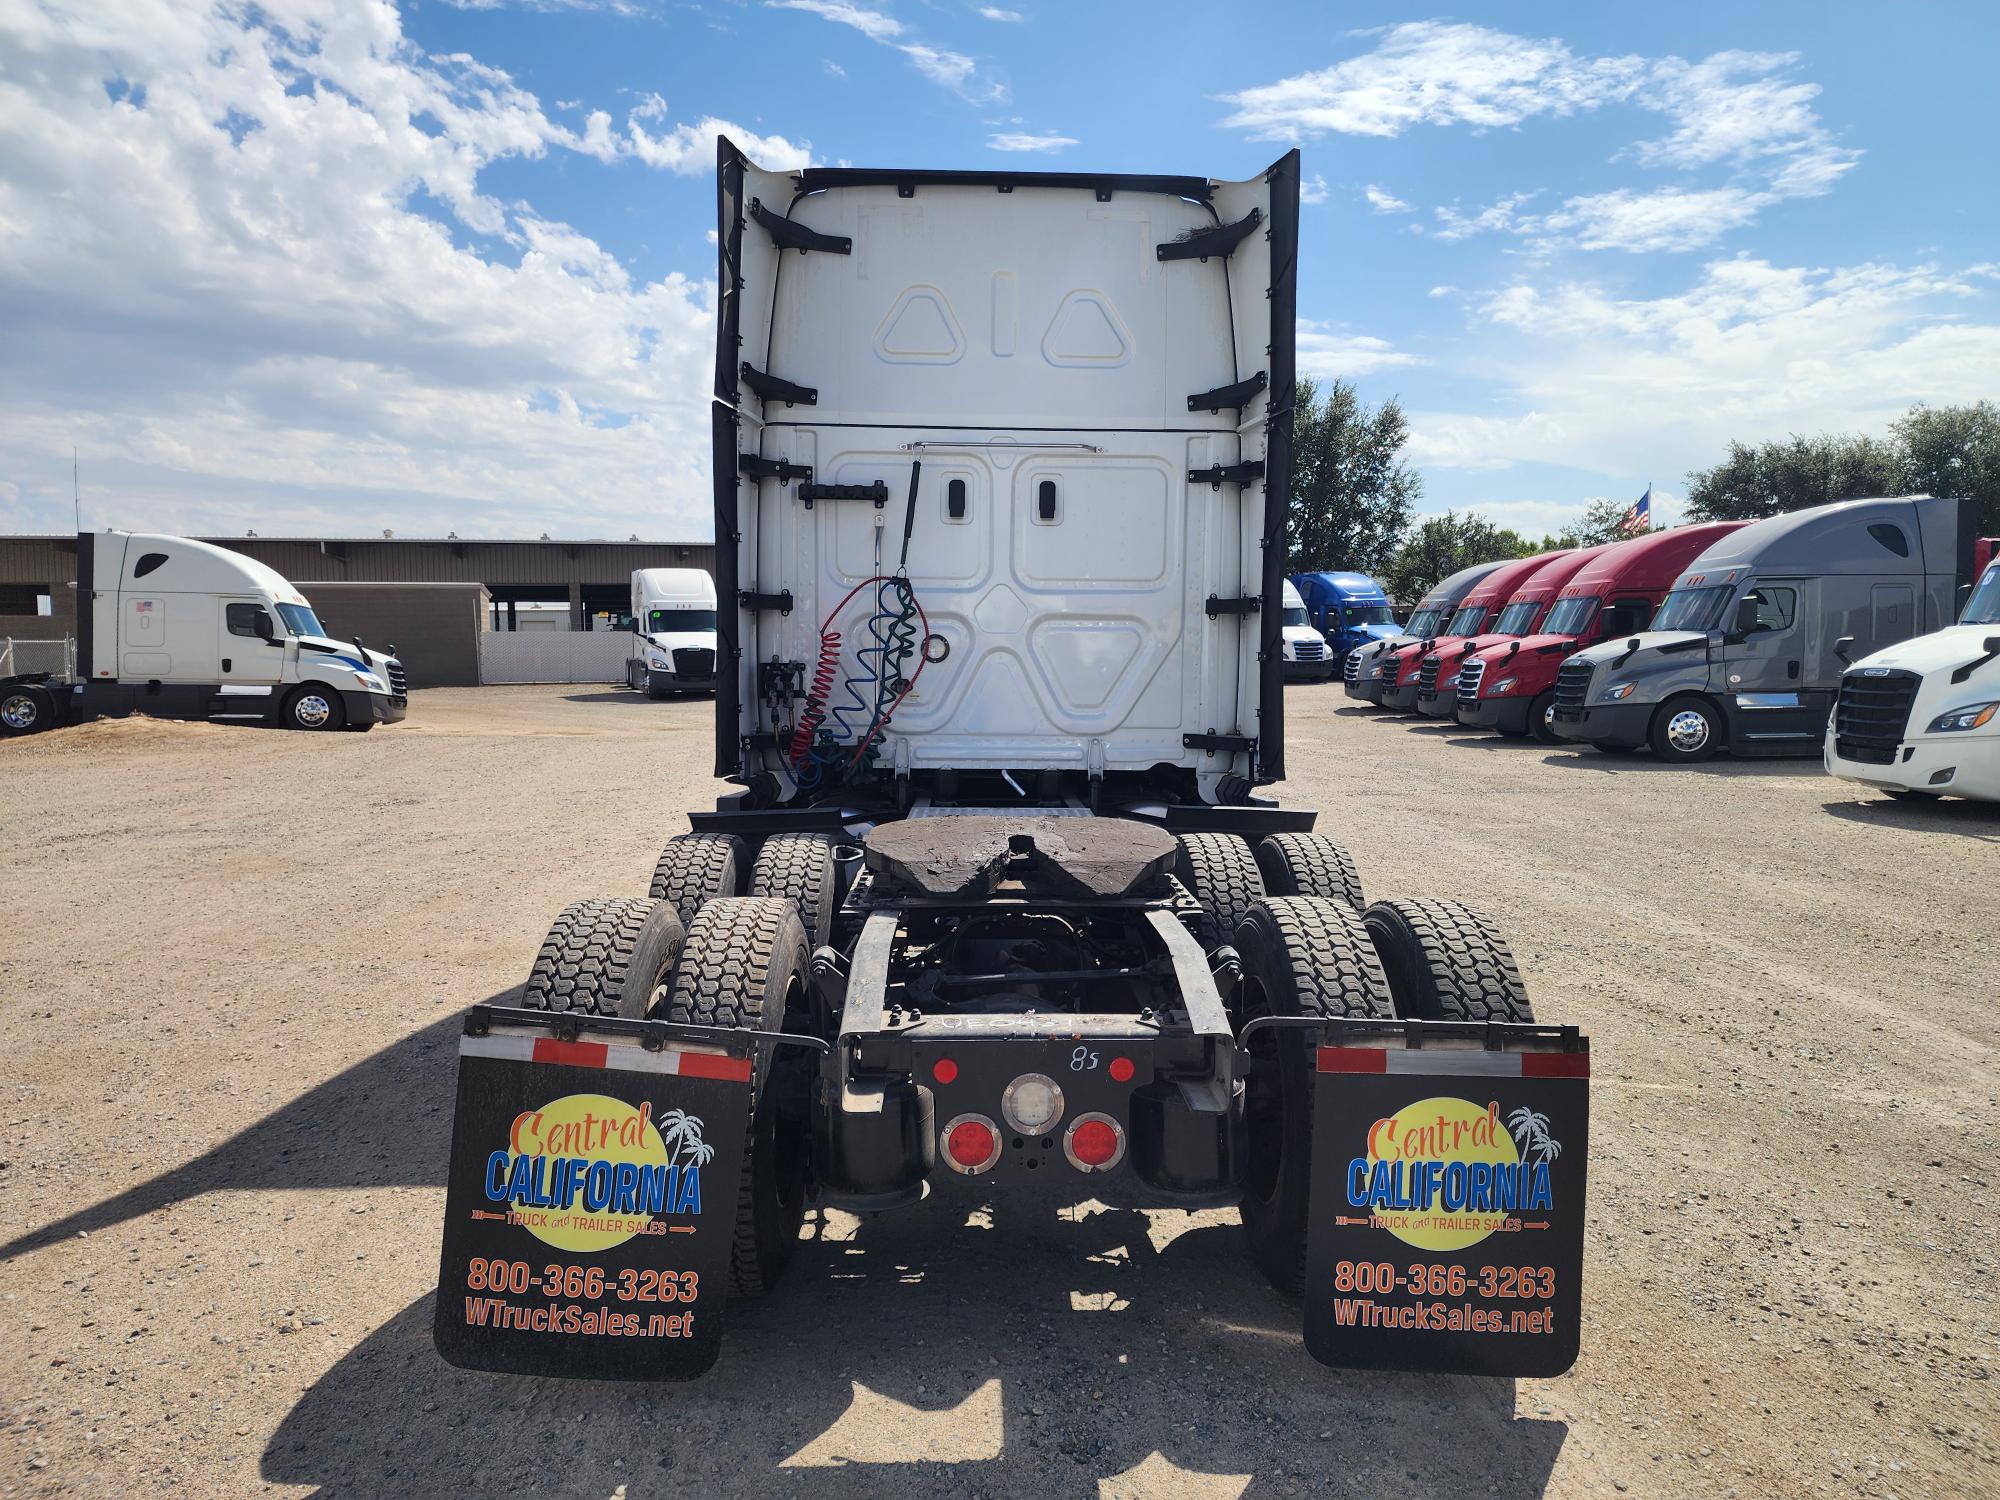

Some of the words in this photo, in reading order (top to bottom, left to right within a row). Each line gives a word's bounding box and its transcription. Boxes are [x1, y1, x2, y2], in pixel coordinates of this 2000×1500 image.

[1070, 1045, 1101, 1071] 85
[510, 1101, 652, 1158] Central
[1367, 1100, 1501, 1164] Central
[485, 1150, 702, 1215] CALIFORNIA
[1347, 1157, 1553, 1211] CALIFORNIA
[505, 1210, 547, 1226] TRUCK
[551, 1213, 571, 1230] and
[572, 1216, 622, 1232] TRAILER
[626, 1219, 667, 1235] SALES
[1368, 1214, 1409, 1230] TRUCK
[1412, 1214, 1430, 1231] and
[1432, 1217, 1480, 1231] TRAILER
[1485, 1217, 1522, 1232] SALES
[467, 1257, 699, 1303] 800-366-3263
[1334, 1260, 1556, 1299] 800-366-3263
[465, 1296, 694, 1338] WTruckSales.net
[1333, 1298, 1554, 1334] WTruckSales.net
